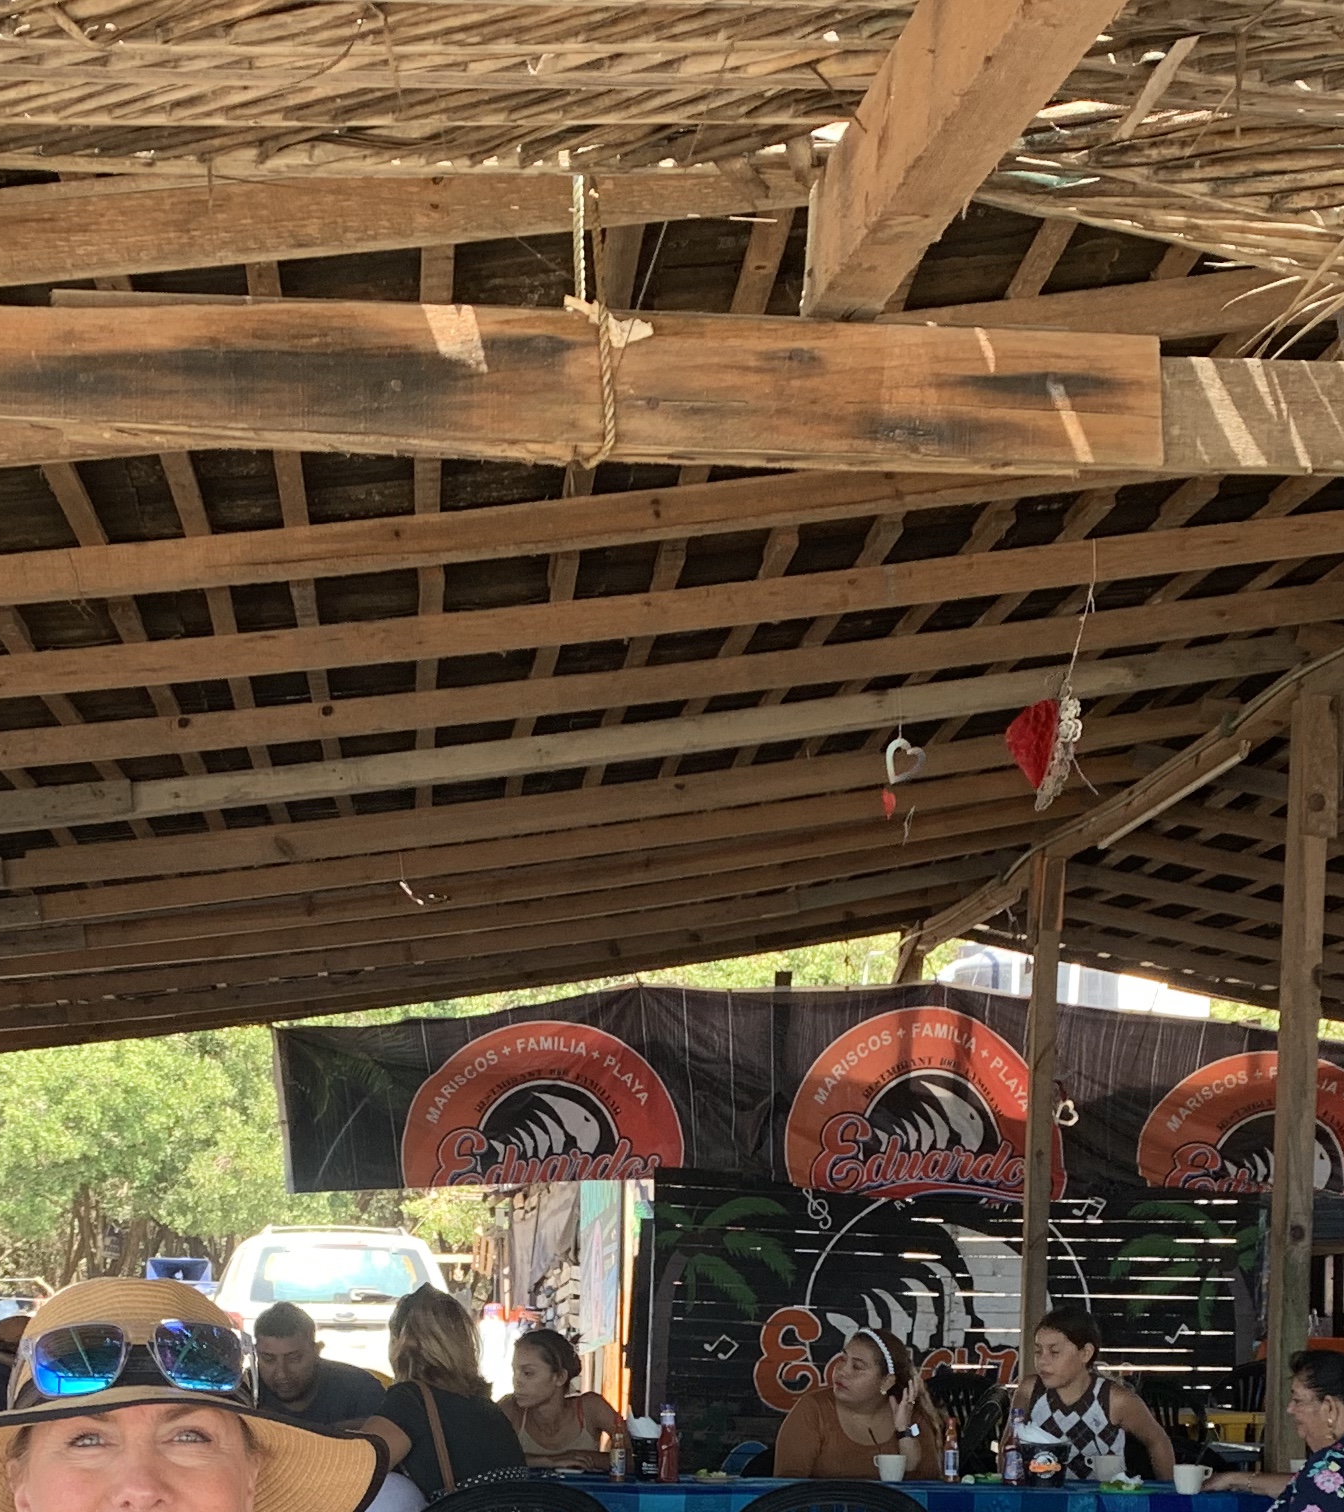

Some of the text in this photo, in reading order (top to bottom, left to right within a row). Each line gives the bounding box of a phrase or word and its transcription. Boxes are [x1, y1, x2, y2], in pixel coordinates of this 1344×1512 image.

[425, 1049, 499, 1125] MARISCOS
[516, 1036, 587, 1057] FAMILIA
[602, 1055, 650, 1107] PLAYA
[813, 1030, 893, 1105] MARISCOS
[912, 1022, 977, 1053] FAMILIA
[989, 1056, 1029, 1113] PLAYA
[1166, 1070, 1249, 1132] MARISCOS
[811, 1112, 1026, 1194] Eduardo
